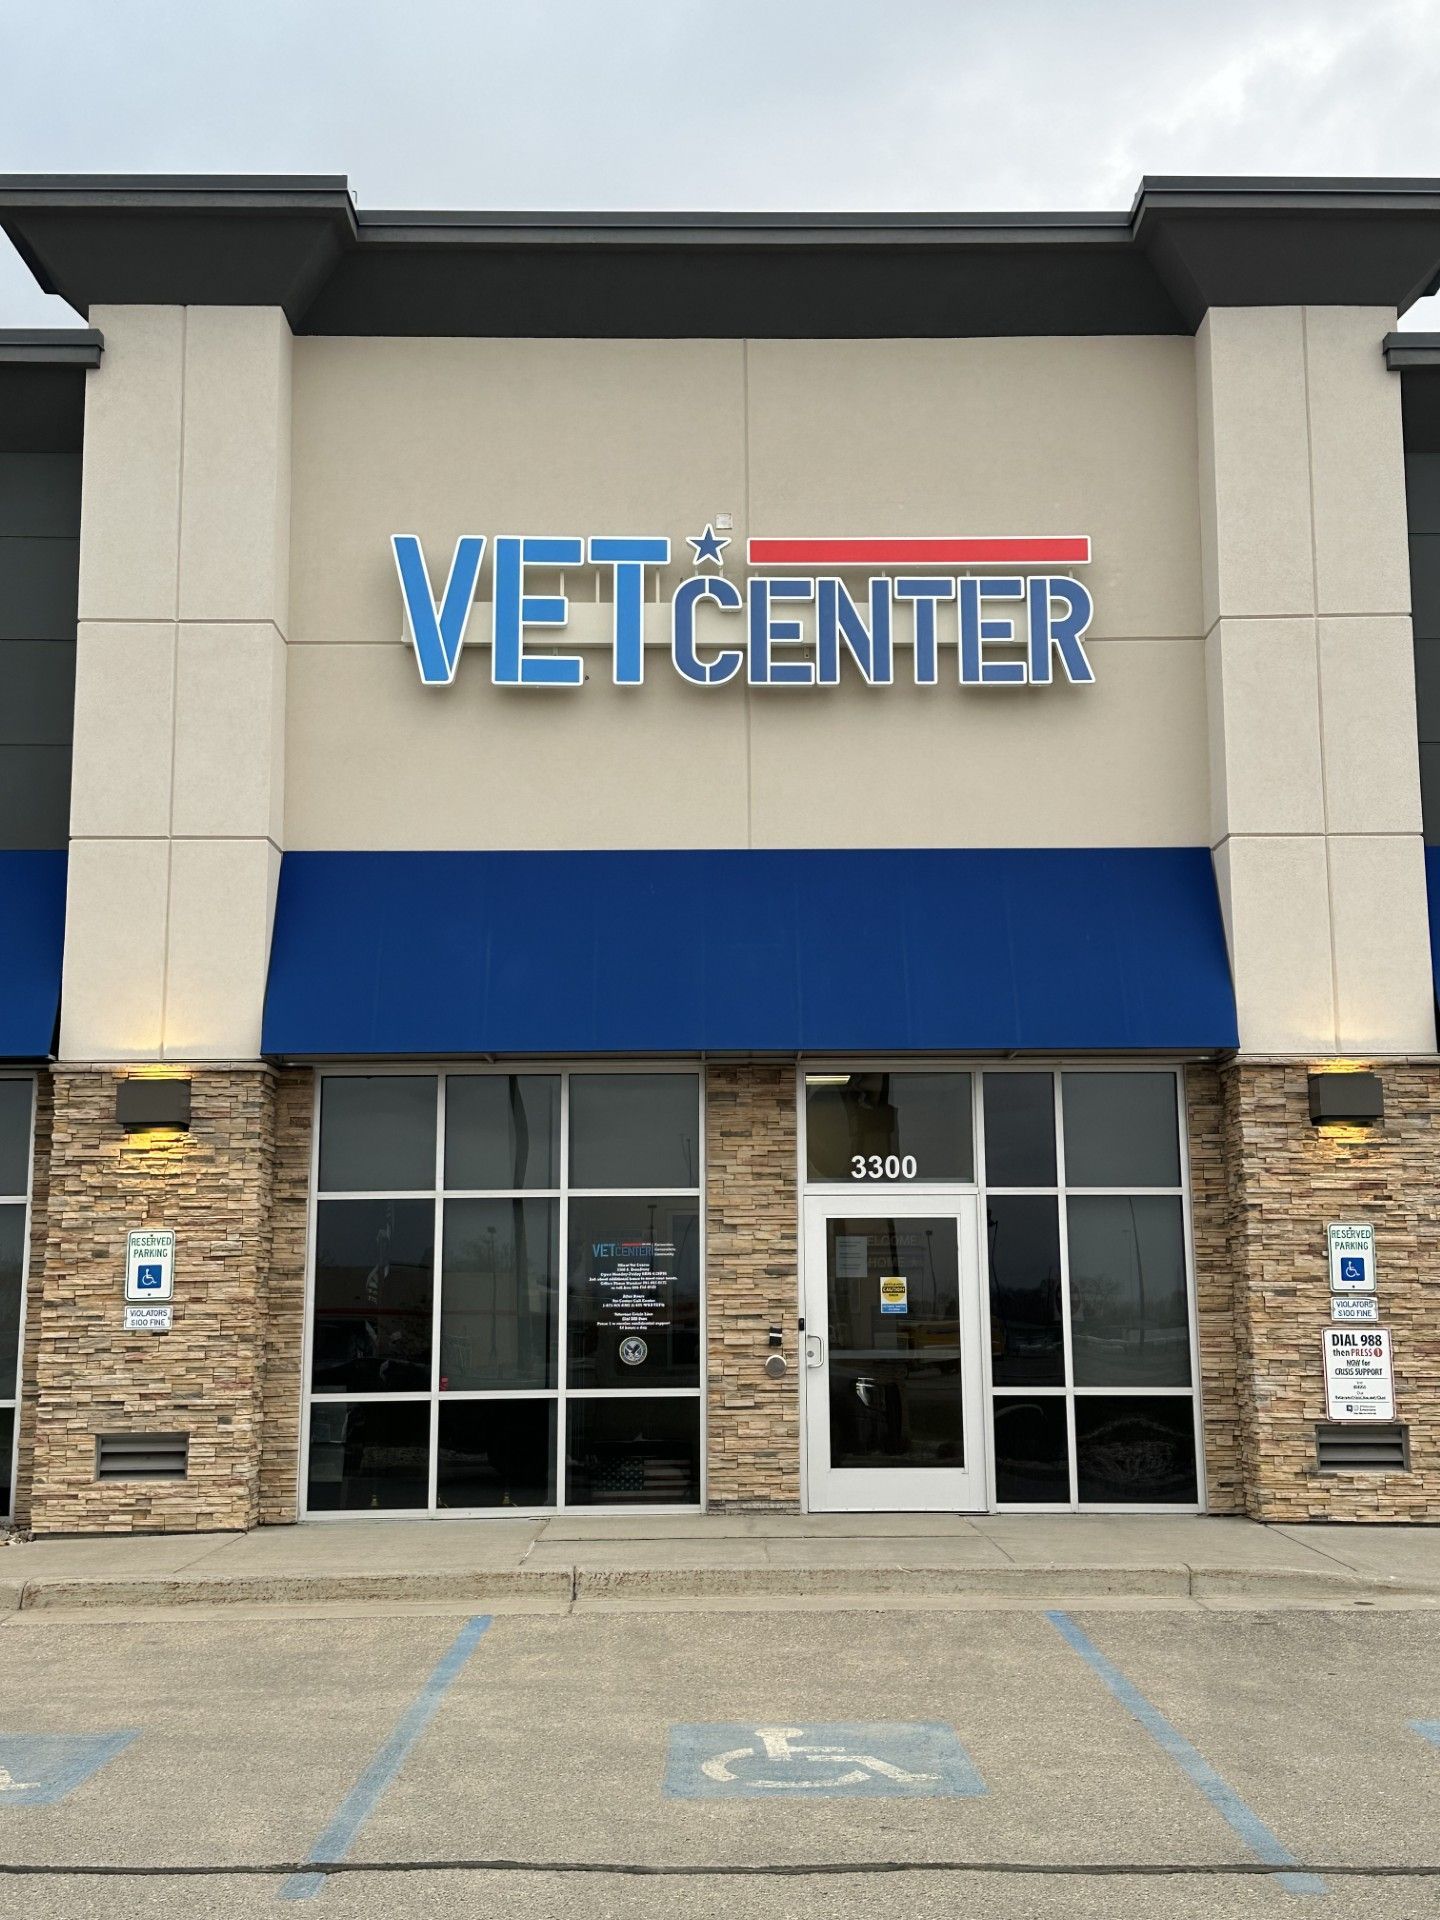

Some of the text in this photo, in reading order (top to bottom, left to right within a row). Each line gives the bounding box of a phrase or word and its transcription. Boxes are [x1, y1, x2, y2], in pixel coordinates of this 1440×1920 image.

[390, 534, 1096, 686] VET CENTER
[851, 1155, 917, 1179] 3300
[1331, 1229, 1371, 1239] RESERVED
[131, 1237, 172, 1247] RESERVED
[1334, 1241, 1369, 1250] PARKING
[133, 1248, 168, 1258] PARKING
[592, 1243, 616, 1257] VET
[616, 1247, 652, 1257] CENTER
[1336, 1300, 1374, 1308] VIOLATORS
[130, 1309, 168, 1317] VIOLATORS
[1356, 1309, 1372, 1317] FINE
[149, 1318, 166, 1326] FINE
[1331, 1334, 1383, 1347] DIAL 988
[1333, 1348, 1350, 1357] then
[1350, 1348, 1373, 1357] PRESS
[1346, 1359, 1371, 1367] NOW for
[1334, 1367, 1383, 1376] CRISIS SUPPORT
